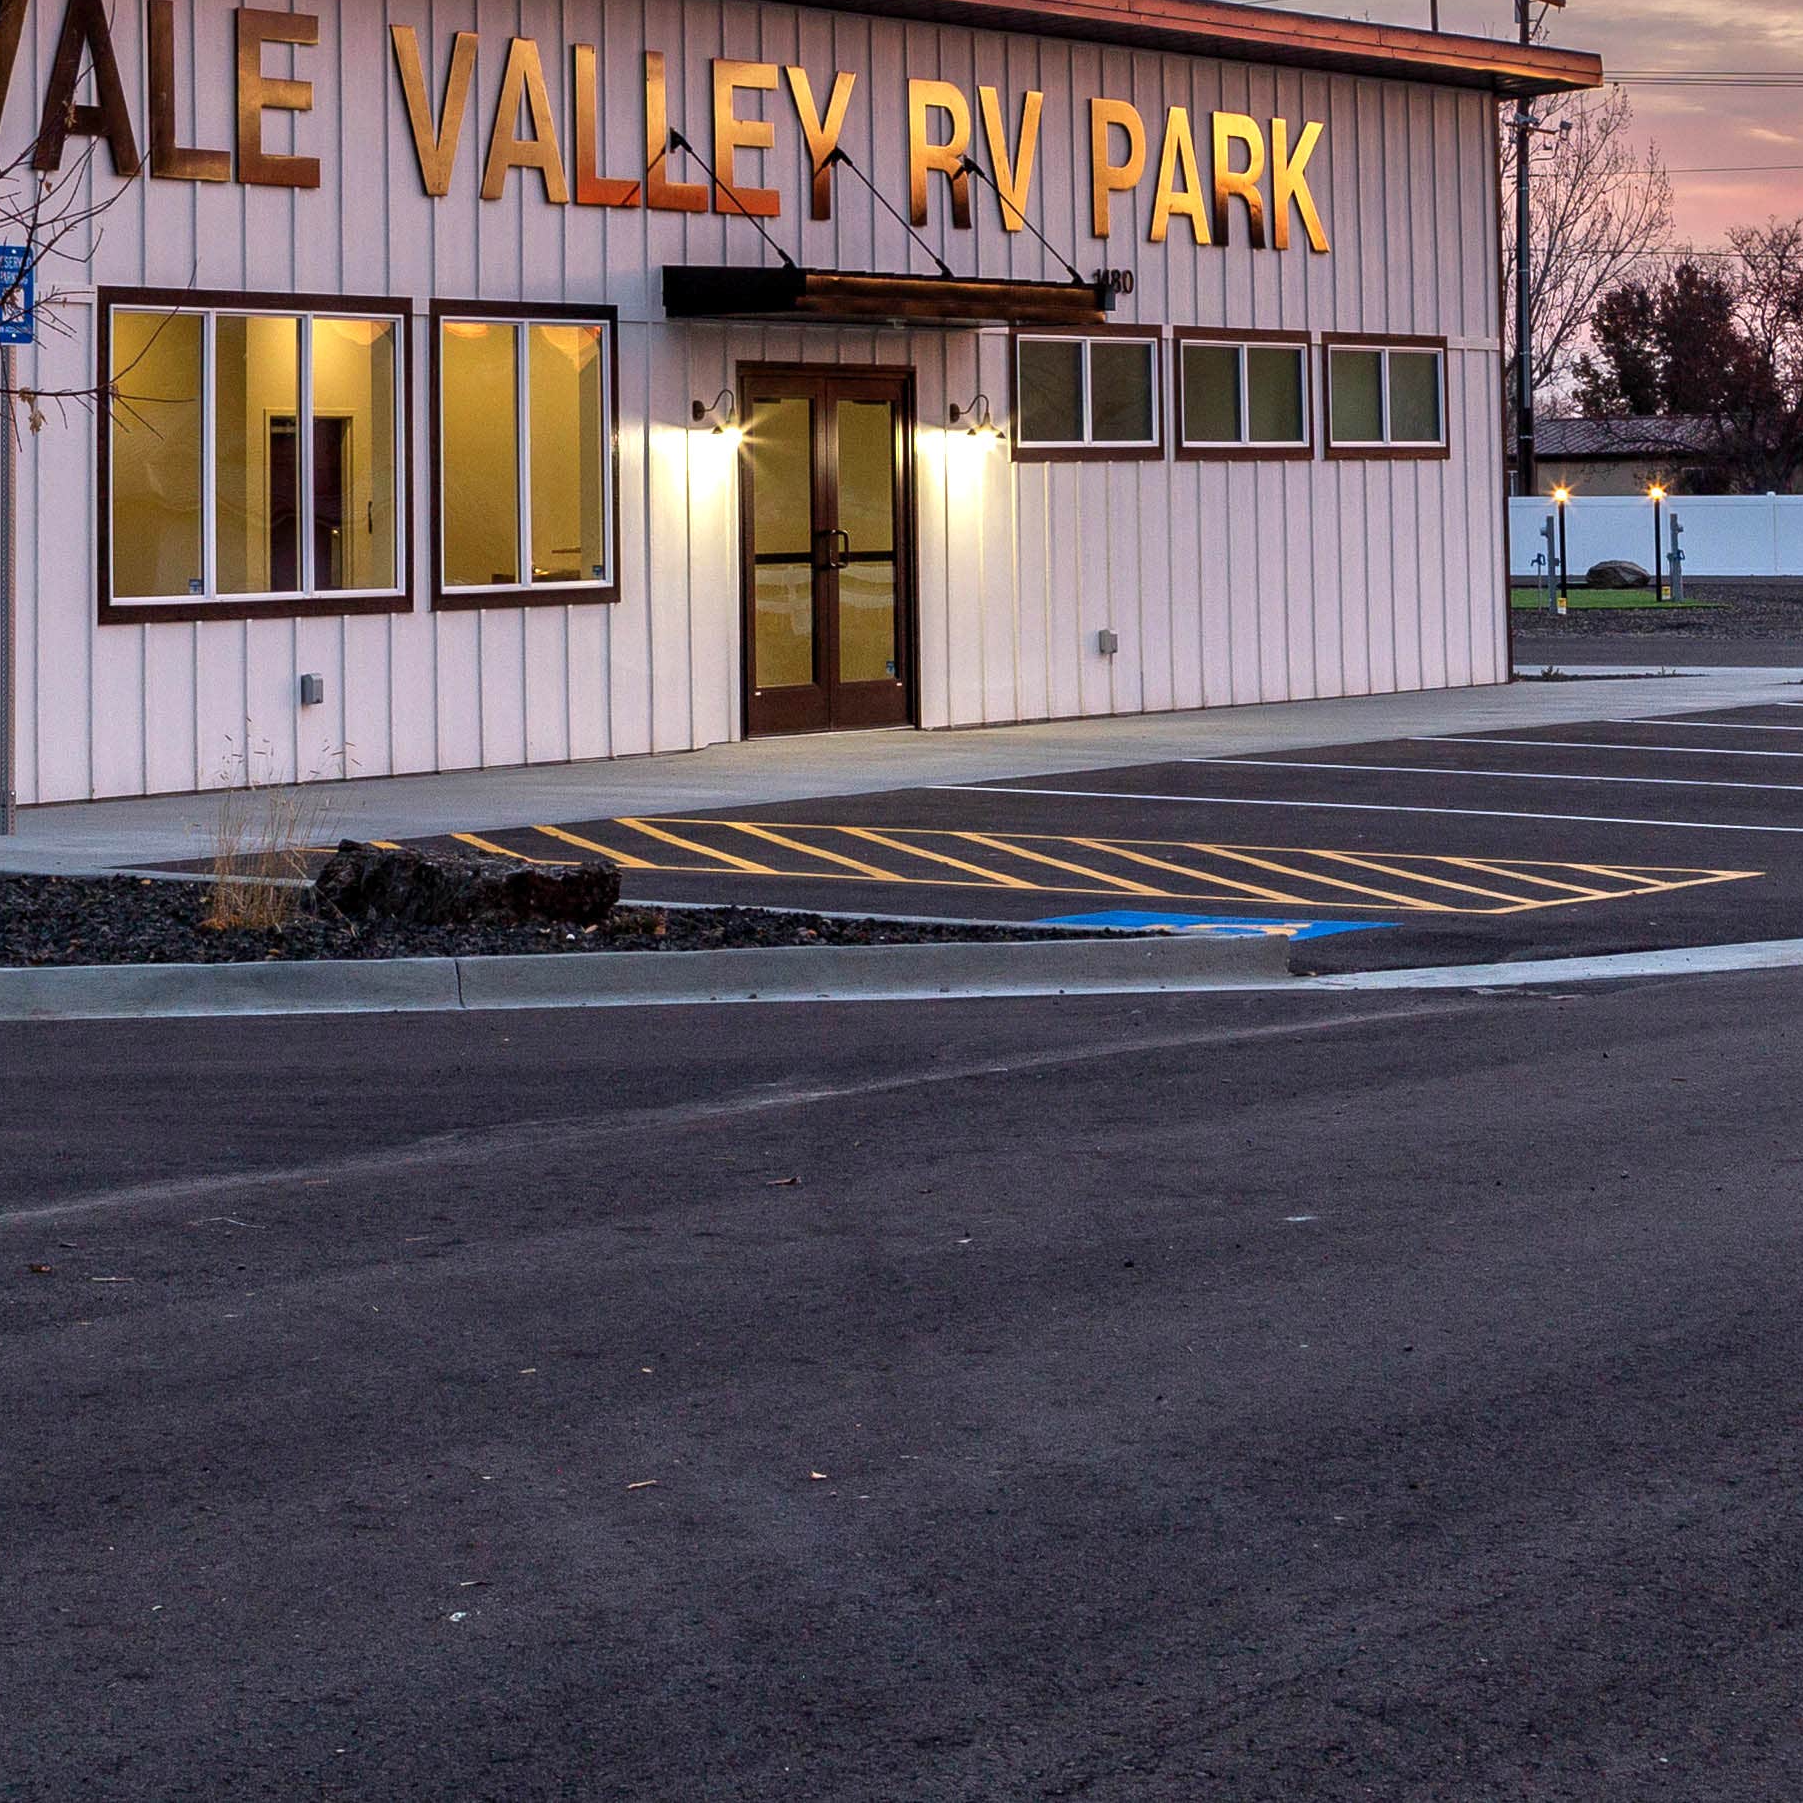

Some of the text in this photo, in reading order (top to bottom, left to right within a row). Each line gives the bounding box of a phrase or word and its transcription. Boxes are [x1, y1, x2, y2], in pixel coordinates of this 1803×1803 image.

[389, 23, 857, 221] VALLEY
[908, 78, 1044, 233] RV
[1091, 97, 1331, 254] PARK
